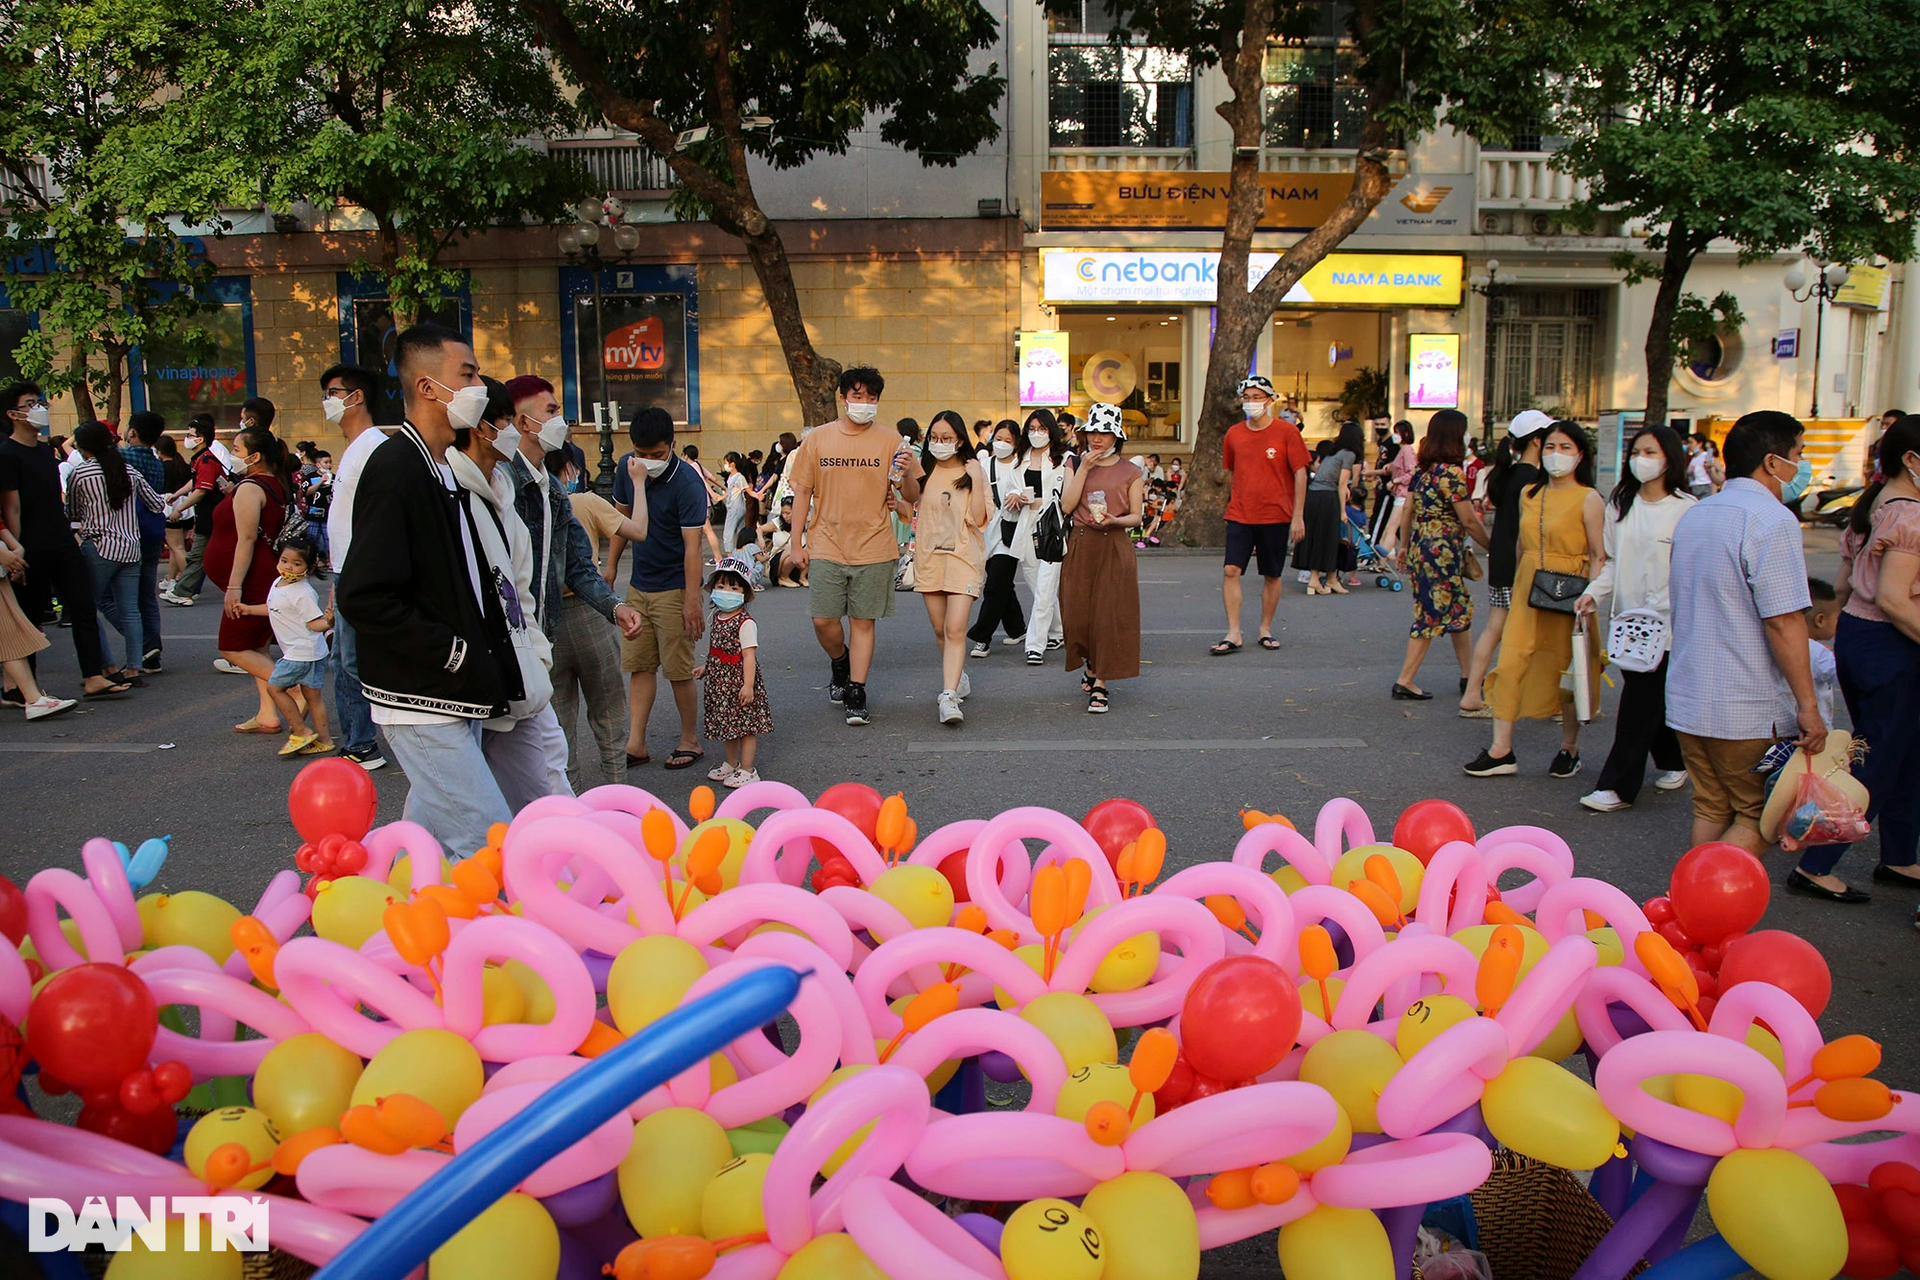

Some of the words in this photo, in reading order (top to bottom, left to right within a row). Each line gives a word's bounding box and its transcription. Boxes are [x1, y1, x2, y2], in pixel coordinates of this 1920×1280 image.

[1119, 184, 1161, 199] BƯU
[1271, 188, 1319, 200] NAM
[1436, 218, 1458, 226] POST
[1331, 272, 1375, 285] NAM
[1377, 273, 1390, 286] A
[1393, 273, 1443, 287] BANK
[1076, 285, 1098, 296] Một
[1777, 344, 1793, 354] ATM
[156, 366, 237, 381] vinaphone
[819, 457, 881, 468] ESSENTIALS
[369, 690, 398, 702] LOUIS
[408, 697, 464, 712] VUITTON
